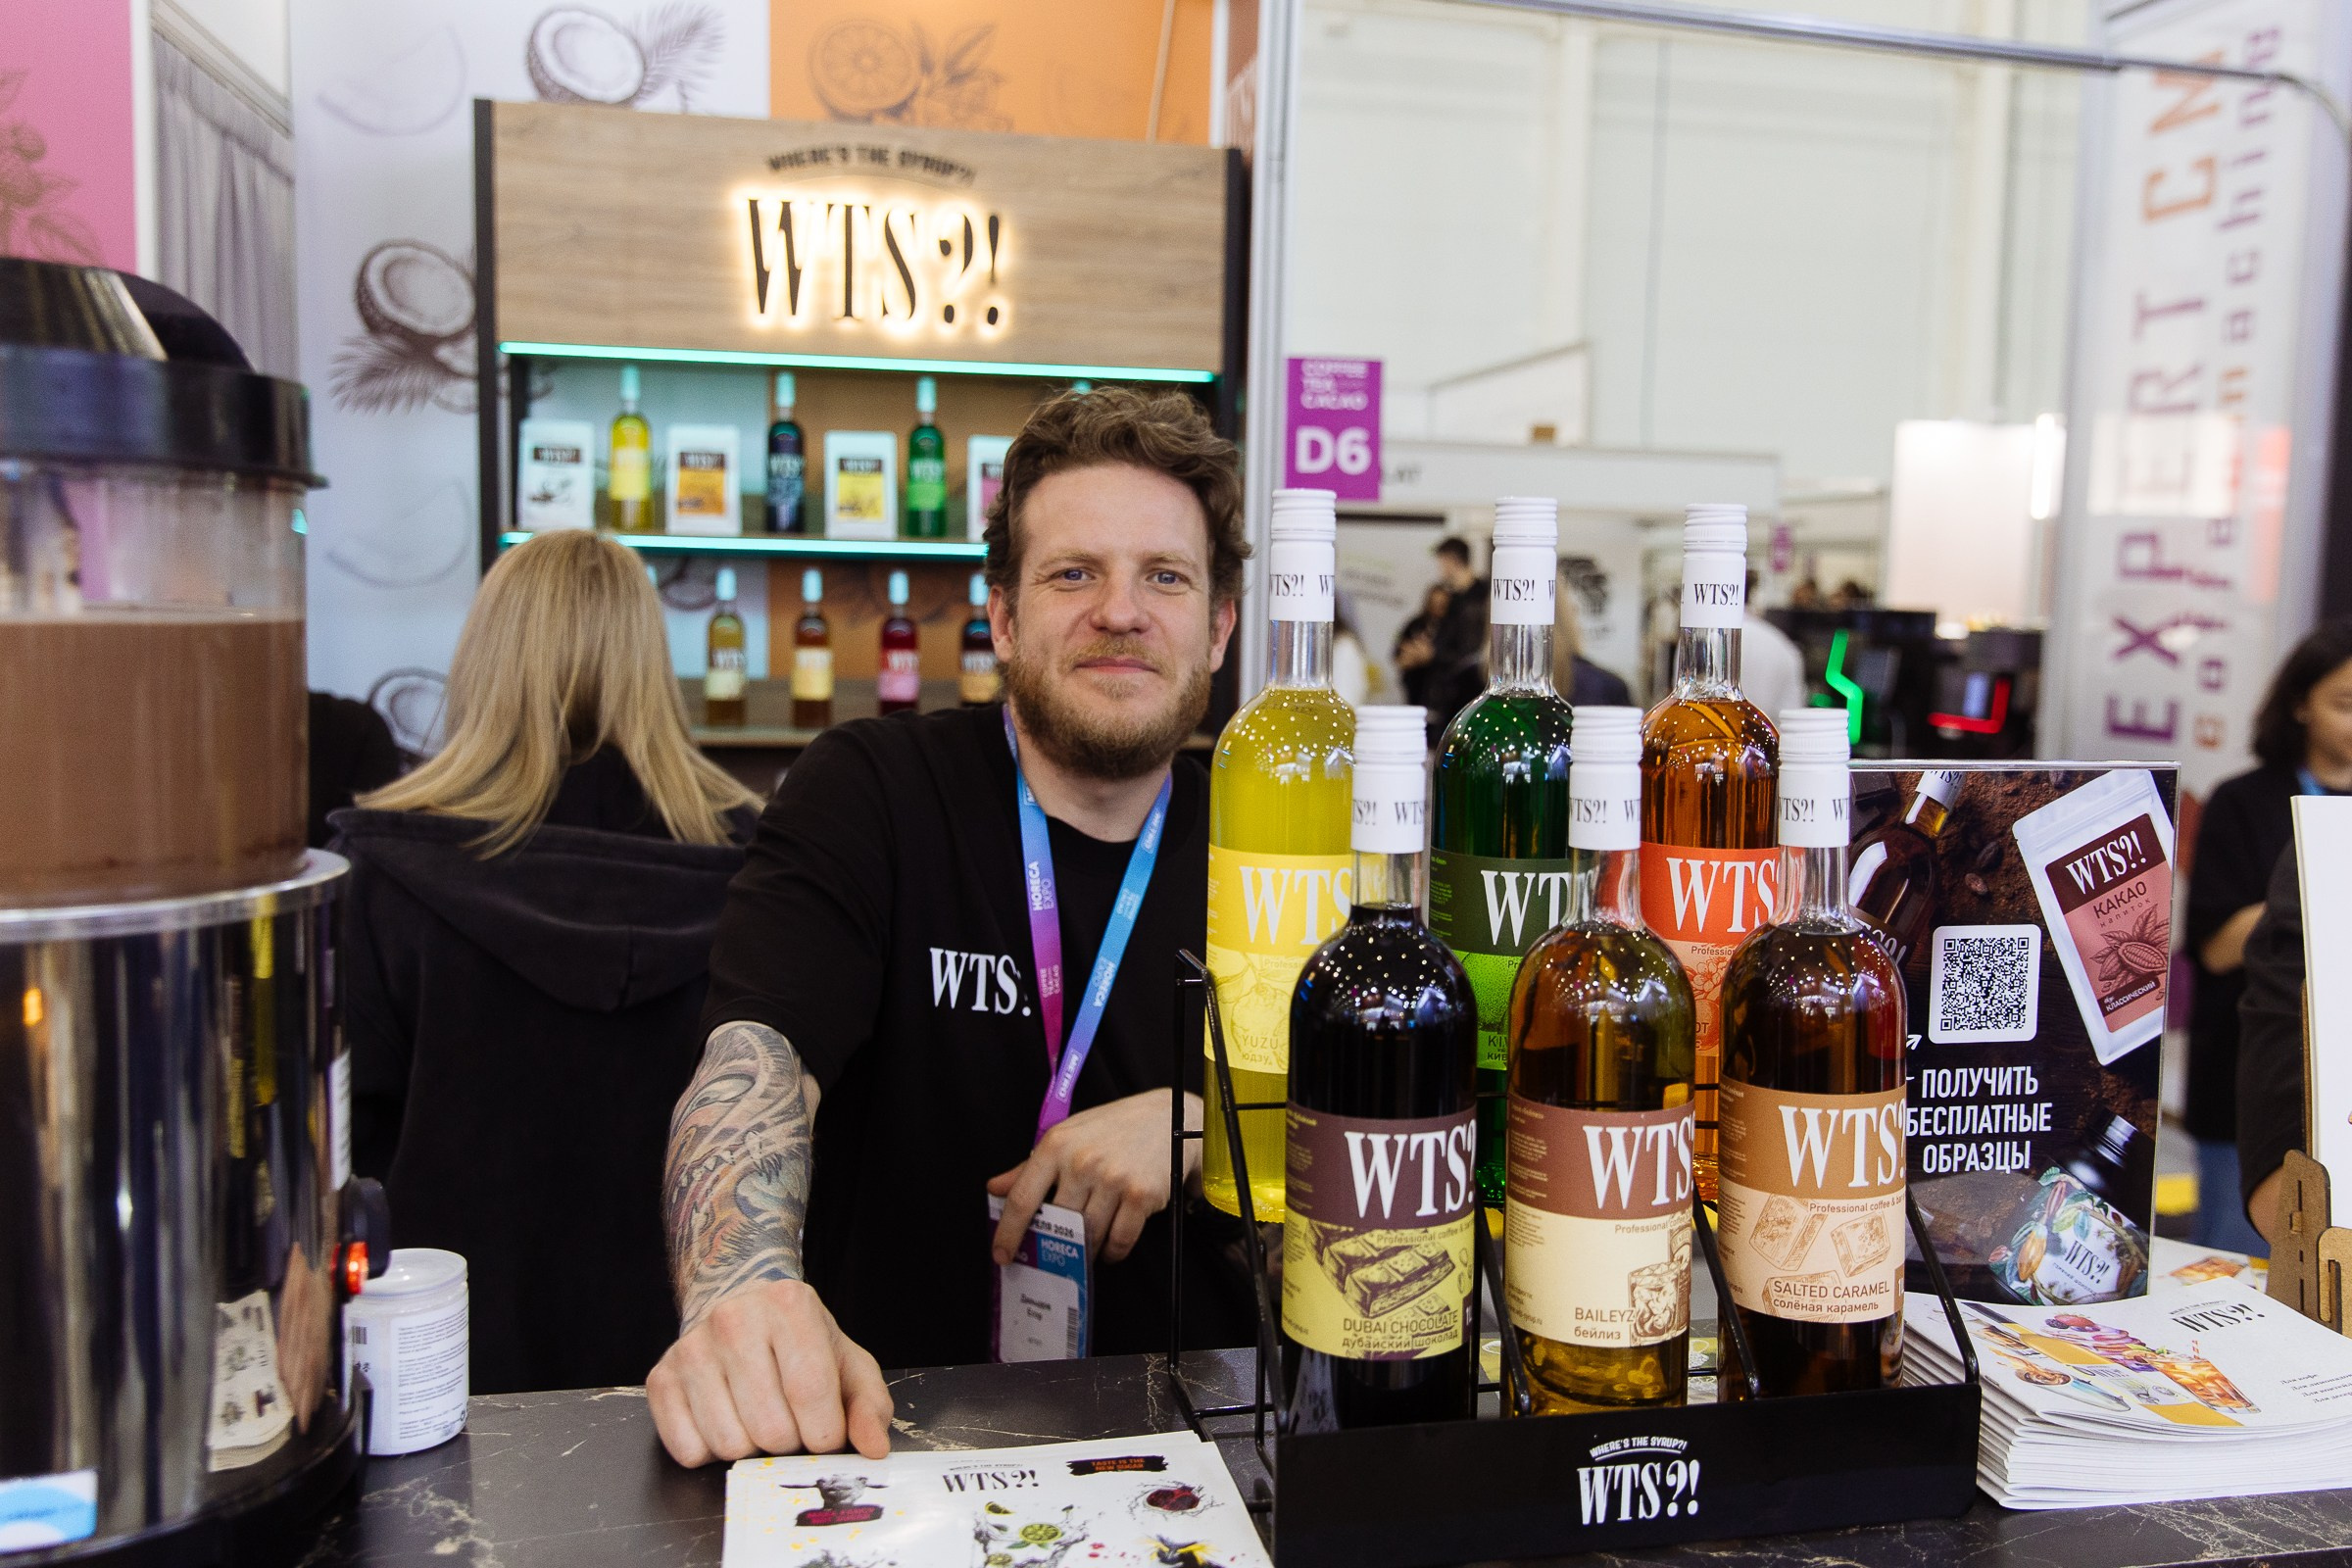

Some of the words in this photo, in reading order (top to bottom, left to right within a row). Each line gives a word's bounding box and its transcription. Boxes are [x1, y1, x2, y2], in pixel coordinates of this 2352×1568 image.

[733, 192, 1007, 331] WTS?!
[1294, 424, 1372, 476] D6
[1493, 578, 1536, 601] WTS?!
[1693, 583, 1740, 606] WTS?!
[2065, 830, 2146, 895] WTS?!
[1027, 860, 1044, 911] HORECA
[1041, 878, 1054, 910] EXPO
[2092, 880, 2148, 919] КАКАО
[2100, 898, 2151, 928] напиток
[1242, 1034, 1280, 1050] YUZU
[1242, 1053, 1272, 1066] юдзу
[1922, 1066, 2039, 1099] ПОЛУЧИТЬ
[1906, 1102, 2053, 1137] БЕСПЛАТНЫЕ
[1583, 1113, 1695, 1210] WTS
[1923, 1141, 2032, 1174] ОБРАЗЦЫ
[1809, 1201, 1867, 1213] Professional
[1869, 1199, 1890, 1210] coffee
[1376, 1231, 1436, 1245] Professional
[1614, 1222, 1668, 1235] Professional
[2064, 1240, 2110, 1284] WTS?!
[1773, 1280, 1829, 1298] SALTED
[1833, 1281, 1890, 1298] CARAMEL
[1574, 1307, 1636, 1323] BAILEYZ
[1773, 1298, 1823, 1312] солёная
[1826, 1300, 1879, 1315] карамель
[2170, 1302, 2266, 1333] WTS?!
[1343, 1317, 1387, 1333] DUBAI
[1390, 1309, 1459, 1333] CHOCOLATE
[1342, 1334, 1411, 1349] дубайский
[1413, 1329, 1459, 1348] шоколад
[1574, 1326, 1622, 1341] бейлиз
[1589, 1438, 1630, 1458] WHERE'S
[1631, 1436, 1649, 1447] THE
[1650, 1436, 1688, 1450] SYRUP?!
[942, 1469, 1039, 1493] WTS?!
[1577, 1459, 1700, 1526] WTS?!
